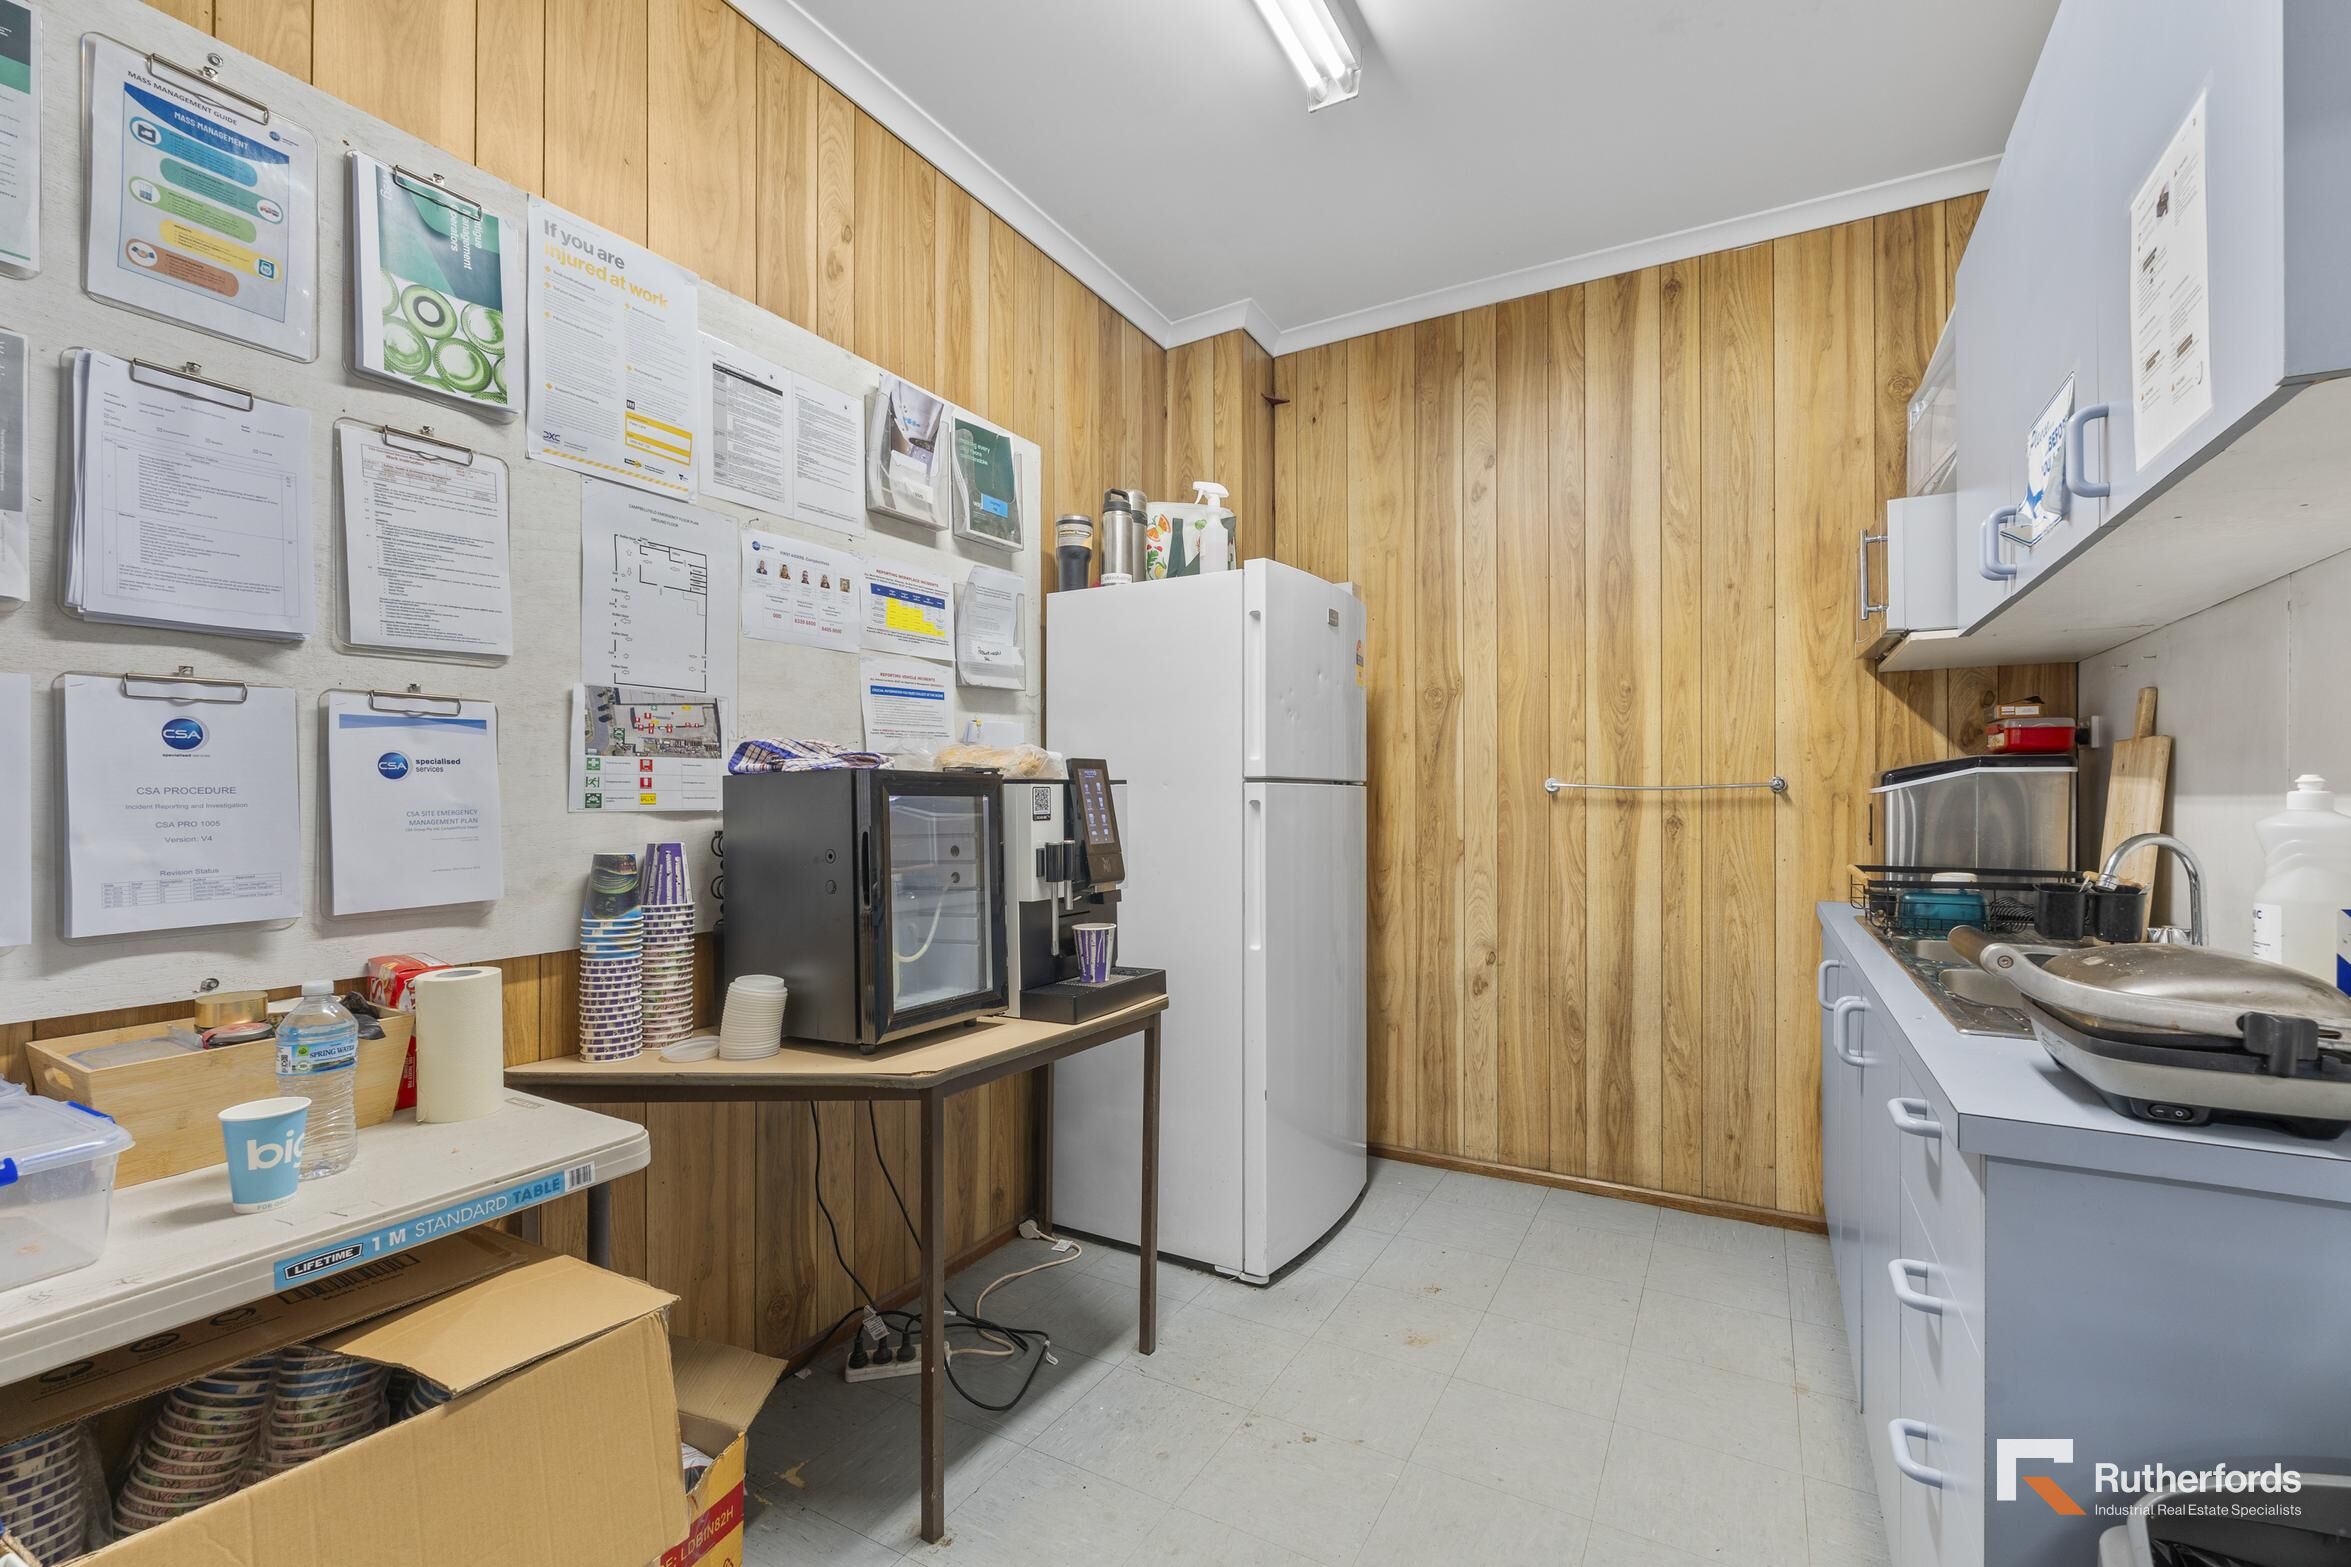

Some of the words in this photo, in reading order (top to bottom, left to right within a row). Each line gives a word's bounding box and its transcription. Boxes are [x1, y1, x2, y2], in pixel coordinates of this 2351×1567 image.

[127, 70, 151, 86] MASS
[153, 82, 213, 114] MANAGEMENT
[213, 110, 238, 126] GUIDE
[174, 112, 196, 127] MASS
[199, 122, 249, 150] MANAGEMENT
[544, 219, 557, 237] If
[561, 230, 594, 255] you
[597, 248, 625, 269] are
[544, 241, 607, 281] injured
[610, 274, 626, 290] at
[629, 282, 668, 307] work
[162, 729, 201, 739] CSA
[379, 762, 407, 770] CSA
[416, 758, 461, 766] specialised
[136, 787, 160, 795] CSA
[164, 786, 237, 795] PROCEDURE
[155, 803, 189, 811] Reporting
[206, 802, 248, 810] Investigation
[437, 809, 478, 817] EMERGENCY
[155, 821, 175, 829] CSA
[160, 869, 193, 877] Revision
[310, 1048, 336, 1058] SPRING
[371, 1237, 380, 1251] 1
[388, 1229, 407, 1245] M
[415, 1196, 508, 1238] STANDARD
[512, 1178, 561, 1205] TABLE
[294, 1248, 354, 1275] LIFETIME
